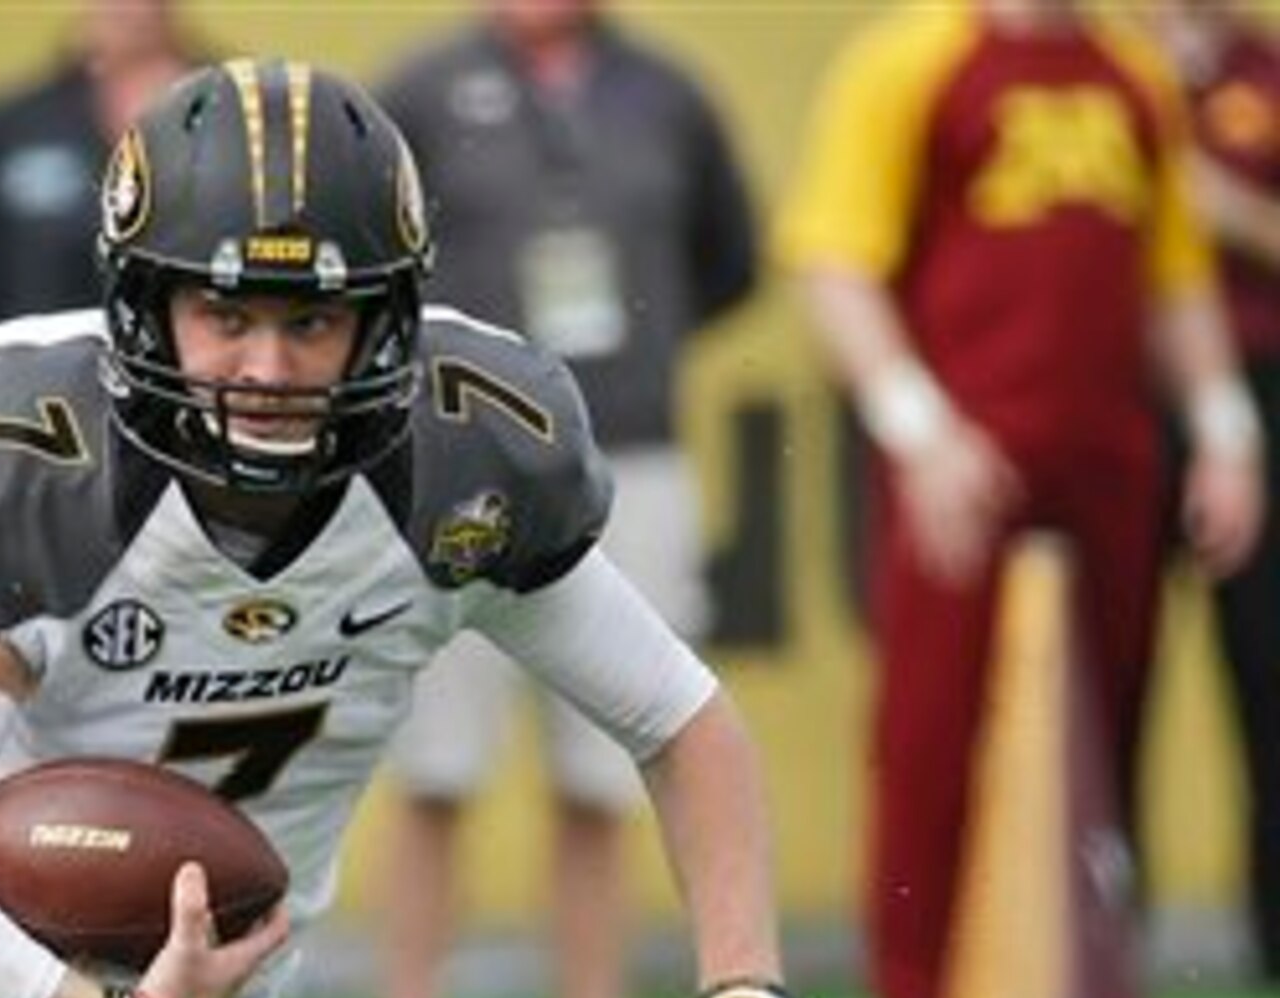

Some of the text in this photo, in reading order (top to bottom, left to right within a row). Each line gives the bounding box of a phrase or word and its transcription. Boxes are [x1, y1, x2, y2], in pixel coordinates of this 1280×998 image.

[432, 356, 554, 443] 7
[90, 604, 158, 664] SEC
[143, 655, 350, 703] MIZZOU
